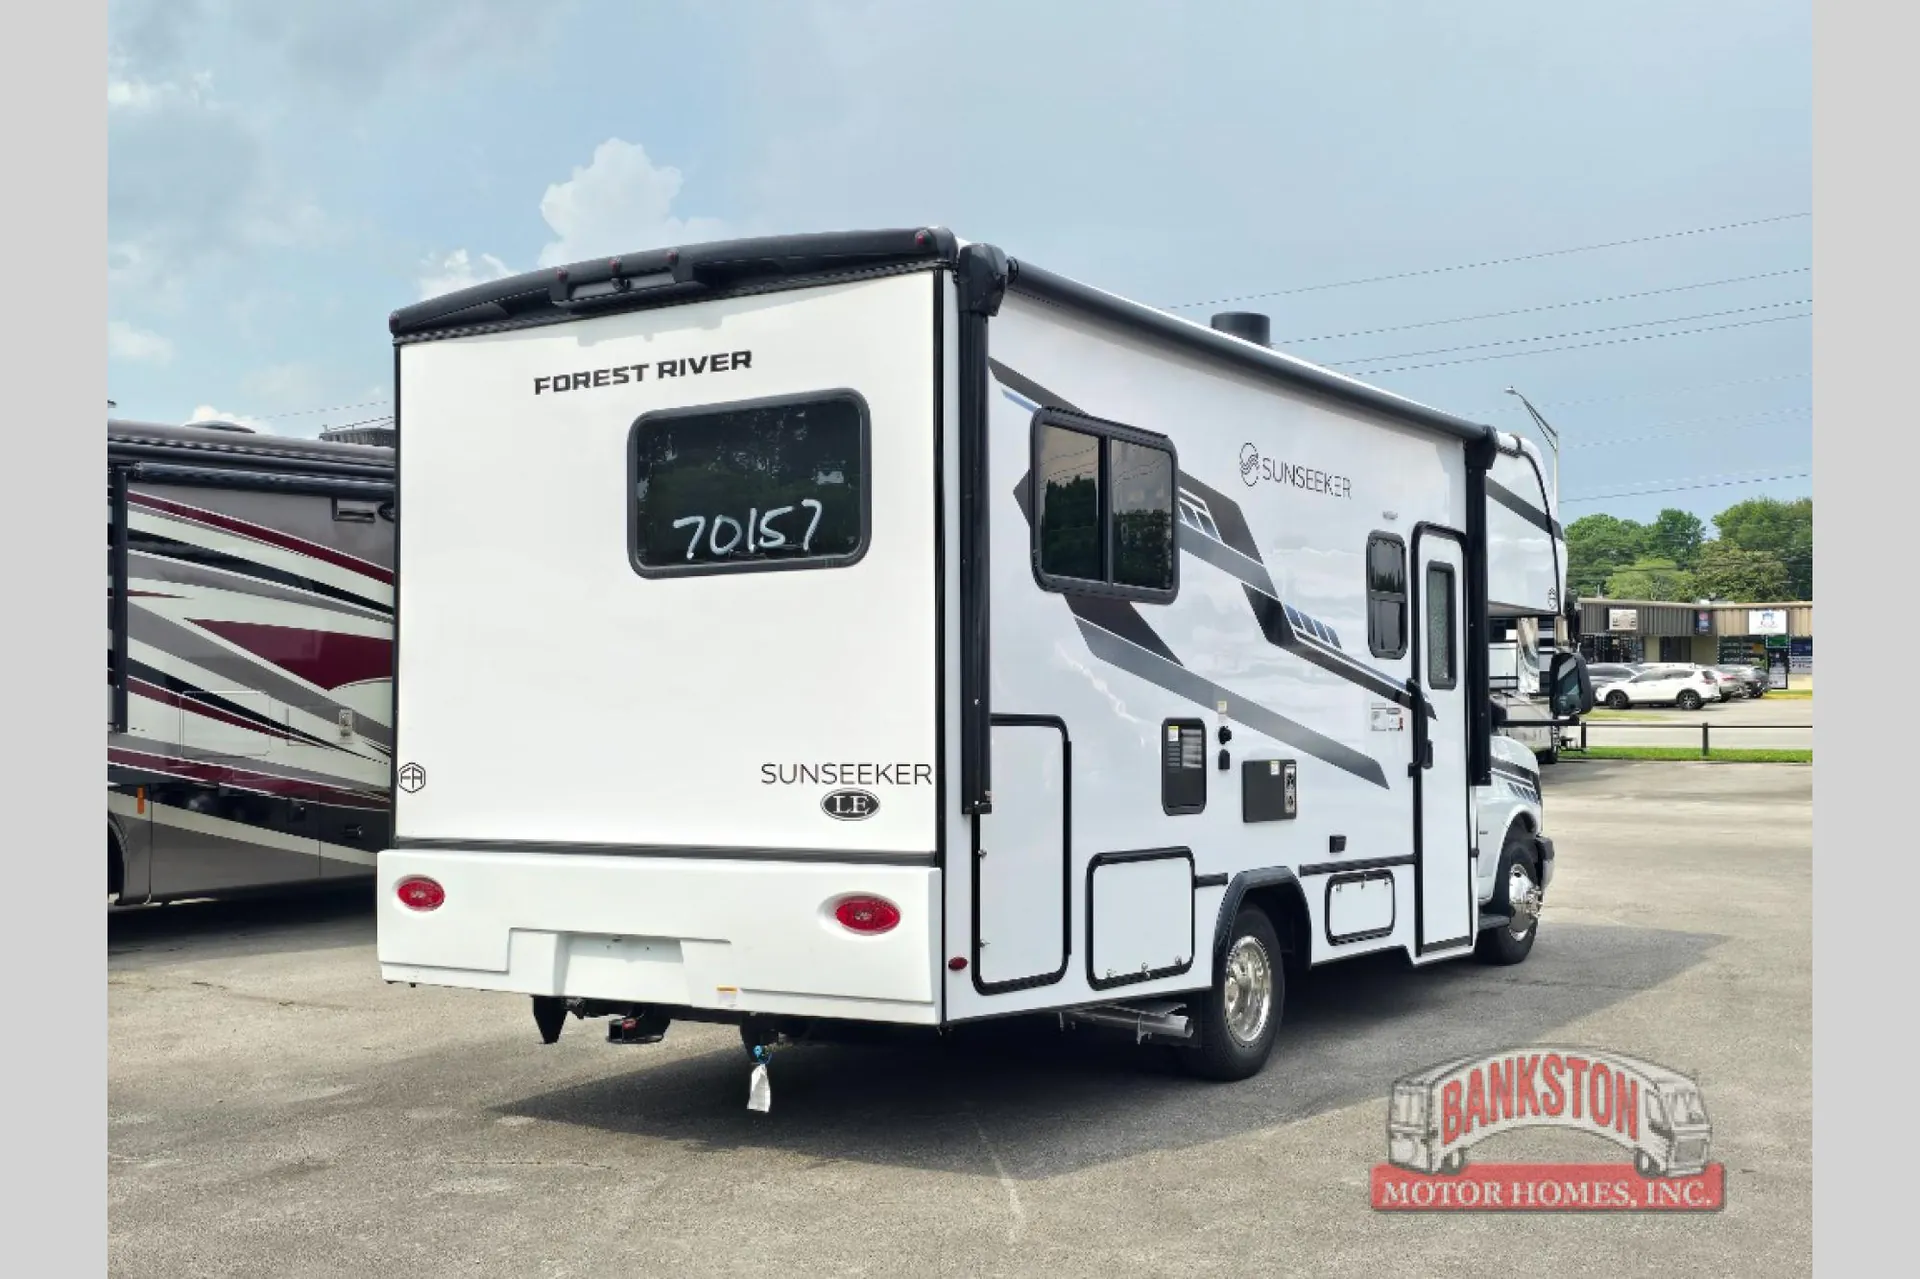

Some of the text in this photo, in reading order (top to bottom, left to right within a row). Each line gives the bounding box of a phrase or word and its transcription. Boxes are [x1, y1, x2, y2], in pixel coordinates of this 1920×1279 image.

[534, 350, 753, 395] FOREST RIVER
[1262, 457, 1352, 500] SUNSEEKER
[672, 499, 823, 560] 70157
[761, 763, 933, 786] SUNSEEKER
[833, 795, 870, 815] LE
